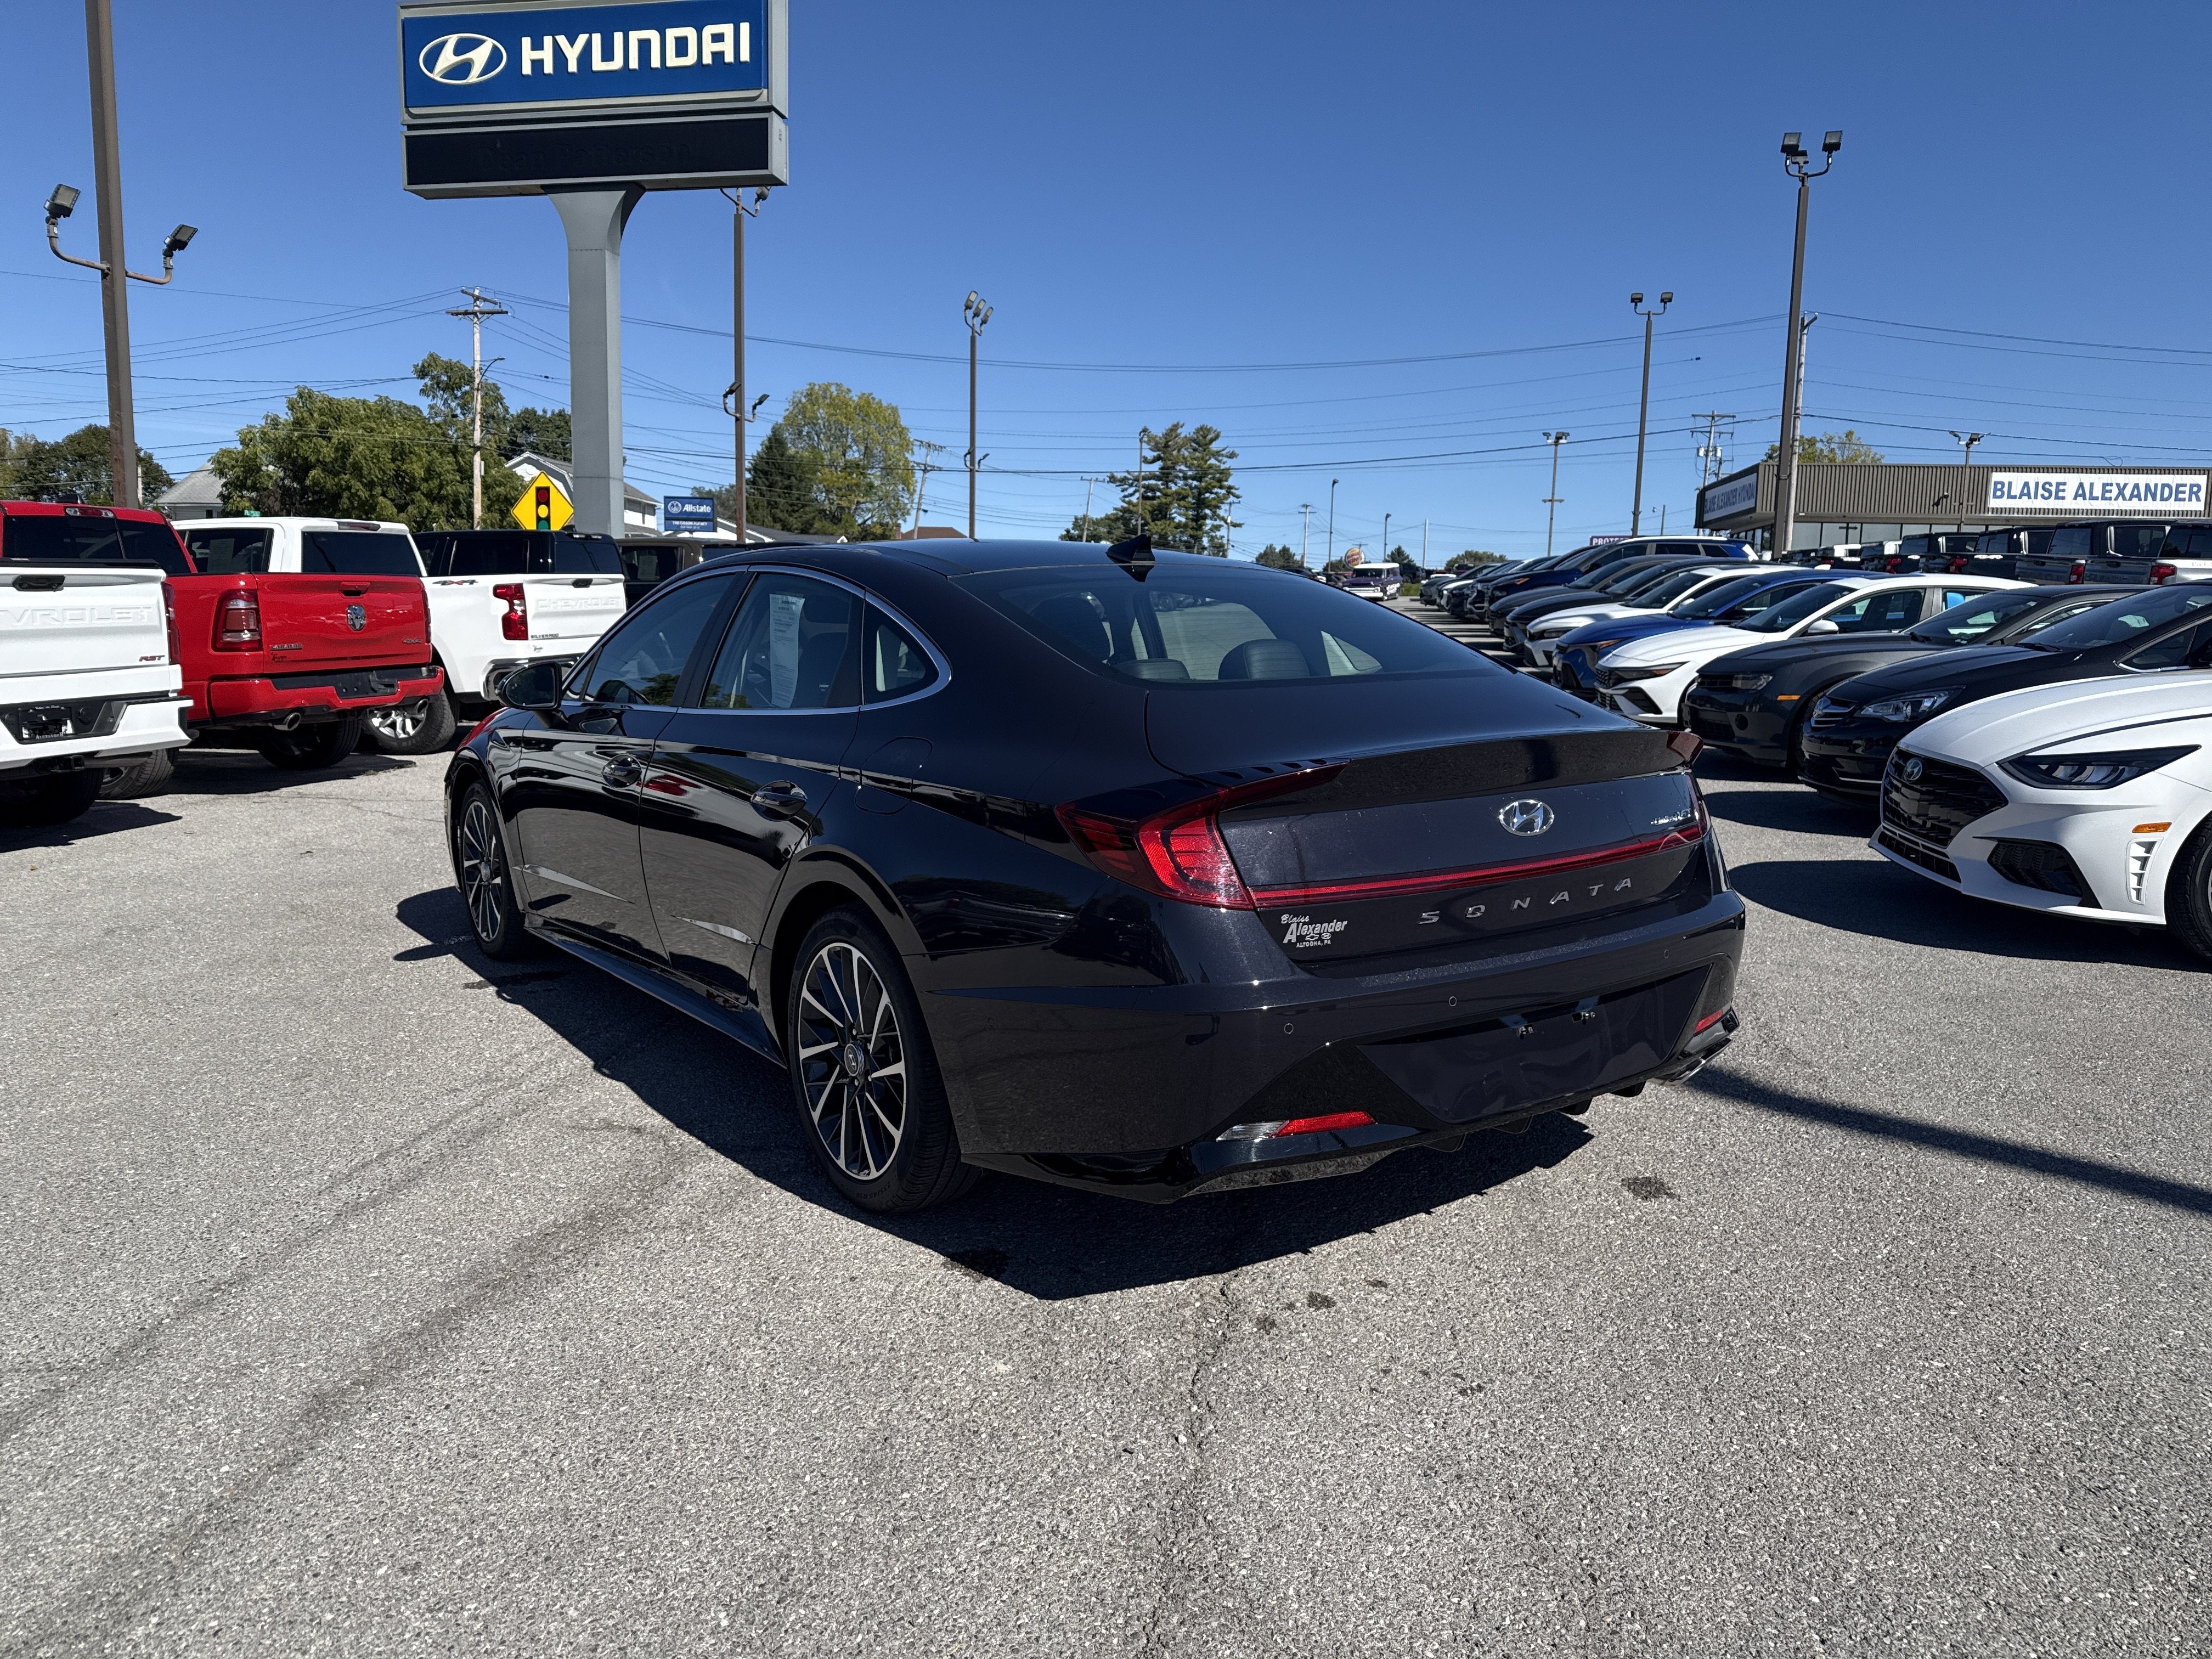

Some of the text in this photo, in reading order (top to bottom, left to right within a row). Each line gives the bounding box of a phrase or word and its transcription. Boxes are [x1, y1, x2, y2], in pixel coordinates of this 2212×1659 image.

[521, 22, 750, 75] HYUNDAI
[1992, 481, 2202, 502] BLAISE ALEXANDER
[682, 504, 711, 512] Allstate
[1417, 878, 1632, 924] SONATA
[1280, 914, 1310, 924] Blaise
[1283, 919, 1348, 943] Alexander
